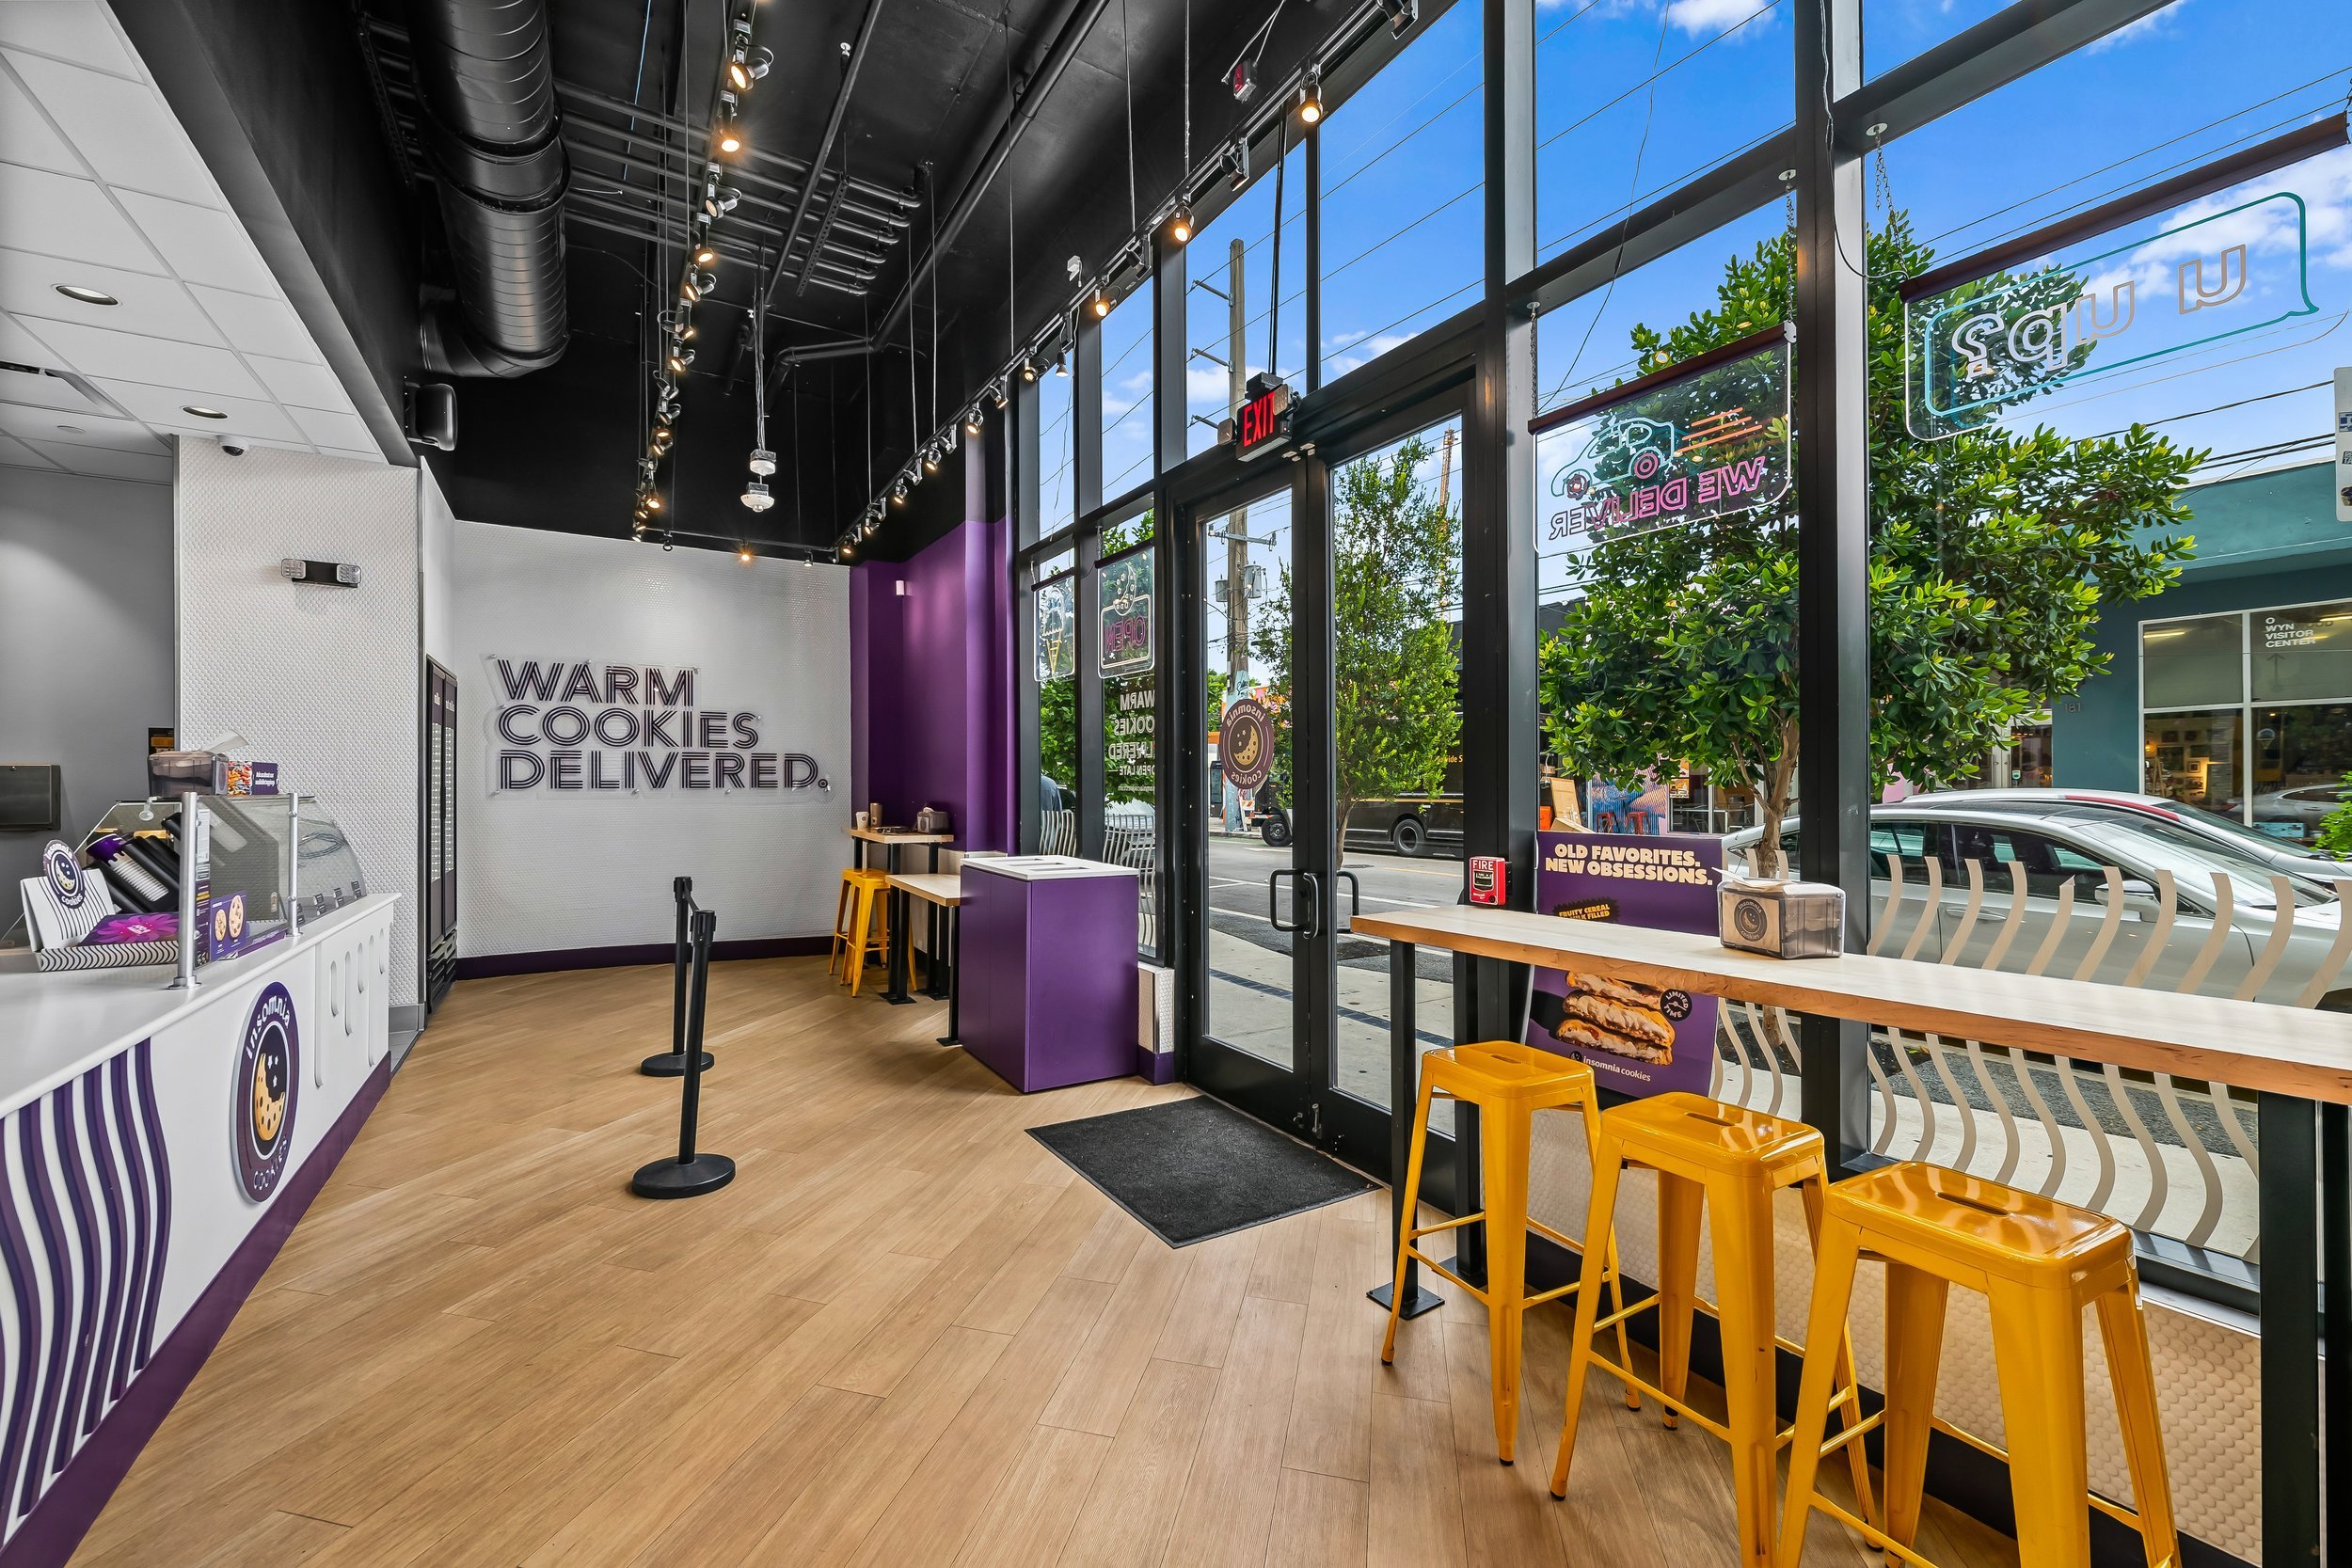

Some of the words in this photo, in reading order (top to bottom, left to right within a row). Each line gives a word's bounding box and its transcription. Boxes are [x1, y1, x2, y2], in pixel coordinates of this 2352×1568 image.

[1244, 390, 1276, 447] EXIT
[2265, 629, 2314, 640] VISITOR
[2265, 639, 2315, 648] CENTER
[497, 658, 694, 707] WARM
[2065, 703, 2081, 713] 181
[498, 704, 759, 750] COOKIES
[500, 749, 829, 790] DELIVERED.
[1472, 860, 1494, 871] FIRE
[1554, 843, 1588, 859] OLD
[1592, 846, 1701, 867] FAVORITES.
[1545, 857, 1585, 874] NEW
[1587, 862, 1713, 886] OBSESSIONS.
[1559, 908, 1582, 918] FRUITY
[1584, 903, 1610, 913] CEREAL
[1587, 910, 1610, 919] FILLED
[1665, 990, 1689, 1008] LIMITED
[1663, 1004, 1683, 1018] TIME
[246, 995, 290, 1060] insomnia
[1583, 1055, 1620, 1073] insomnia
[1620, 1069, 1651, 1082] cookies
